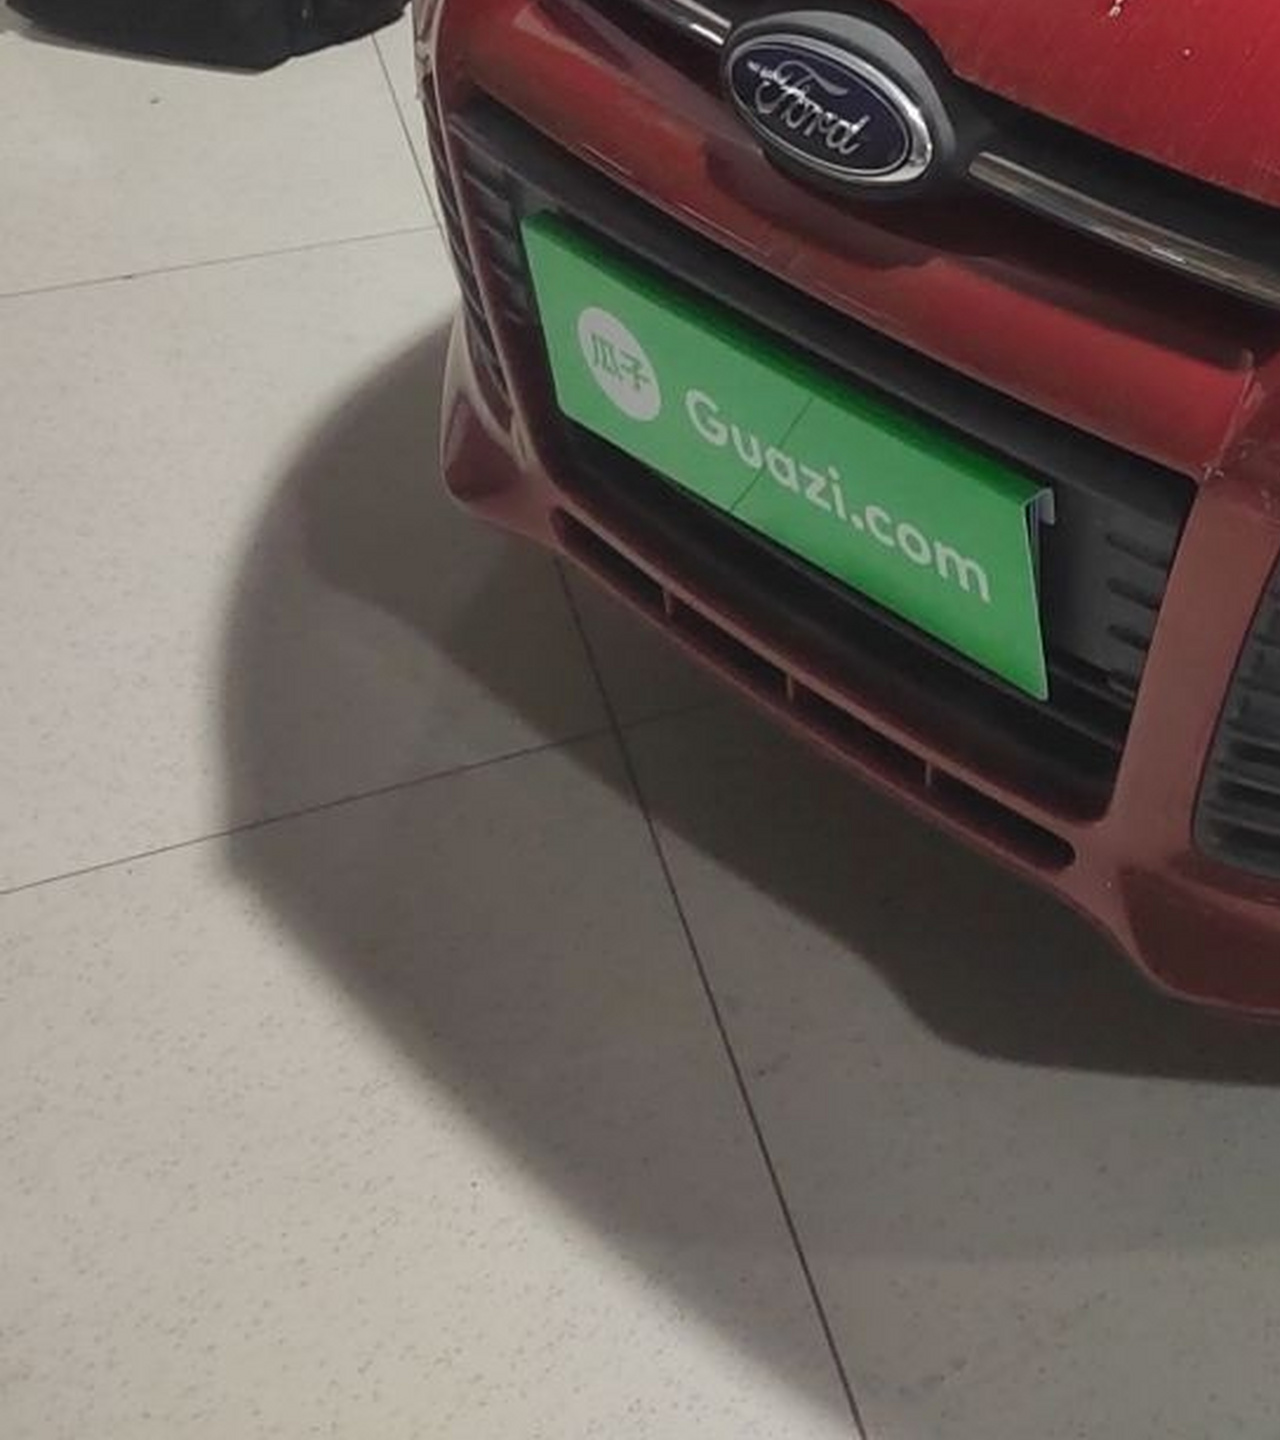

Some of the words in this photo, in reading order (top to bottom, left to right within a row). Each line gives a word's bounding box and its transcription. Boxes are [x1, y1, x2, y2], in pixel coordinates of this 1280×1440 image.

[748, 60, 870, 155] Ford
[590, 331, 653, 392] 瓜子
[685, 388, 991, 603] Guazi.com
